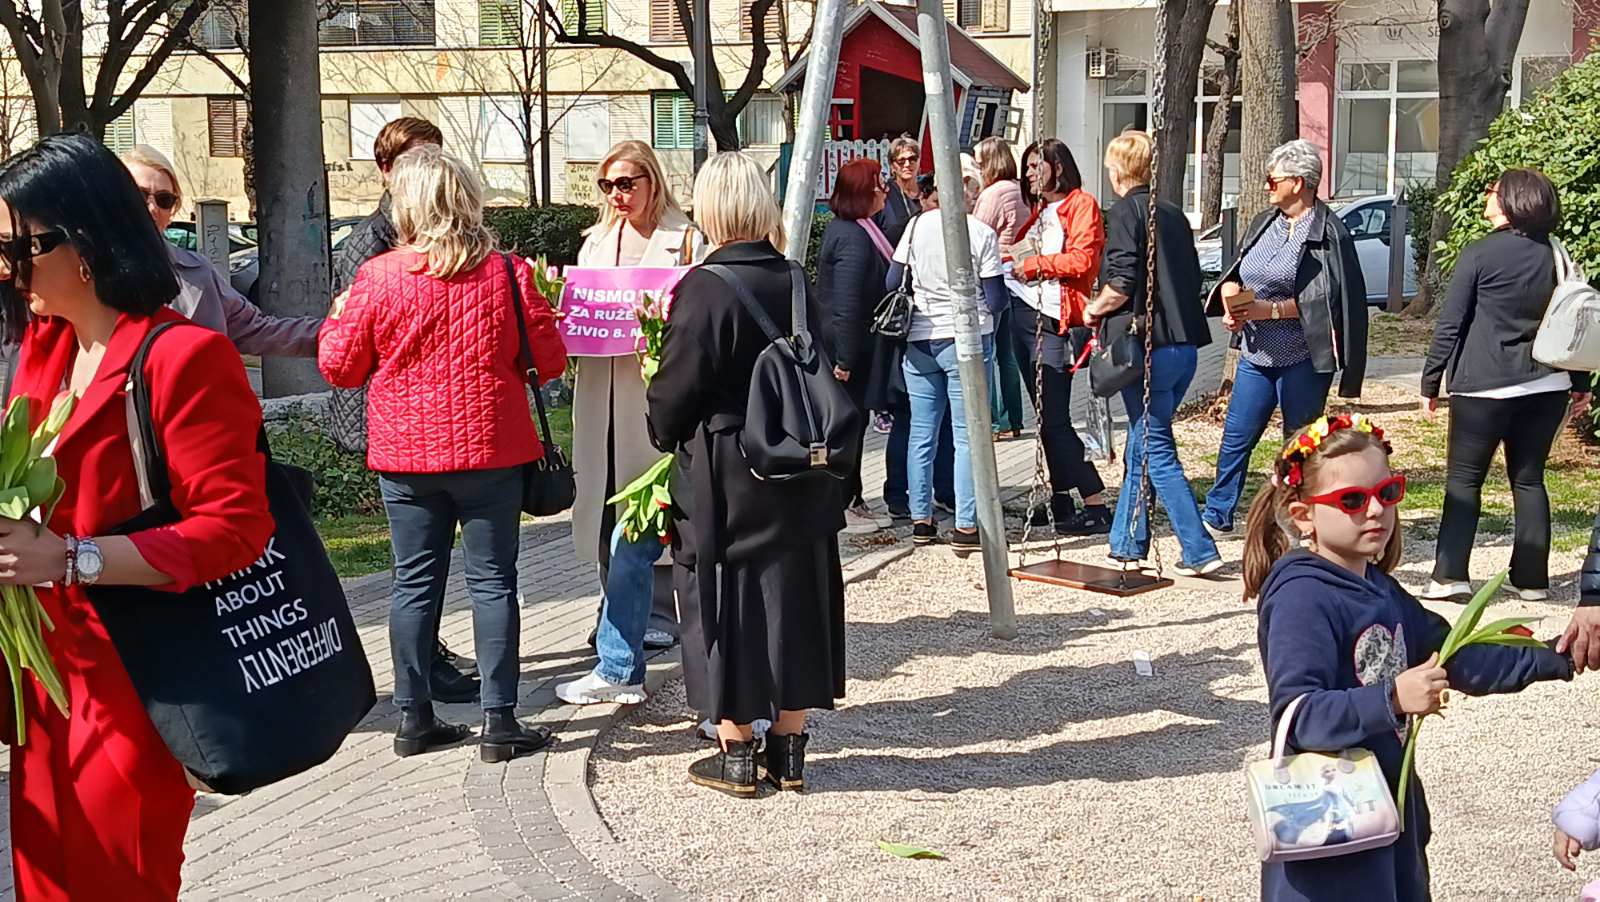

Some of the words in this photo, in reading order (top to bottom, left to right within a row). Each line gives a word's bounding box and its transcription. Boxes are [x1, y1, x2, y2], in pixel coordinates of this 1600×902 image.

[573, 287, 636, 303] NISMO
[569, 305, 590, 318] ZA
[594, 308, 634, 320] RUŽE
[566, 324, 609, 338] ŽIVIO
[613, 328, 626, 338] 8.
[214, 570, 285, 617] ABOUT
[221, 598, 308, 648] THINGS
[238, 617, 343, 693] DIFFERENTLY
